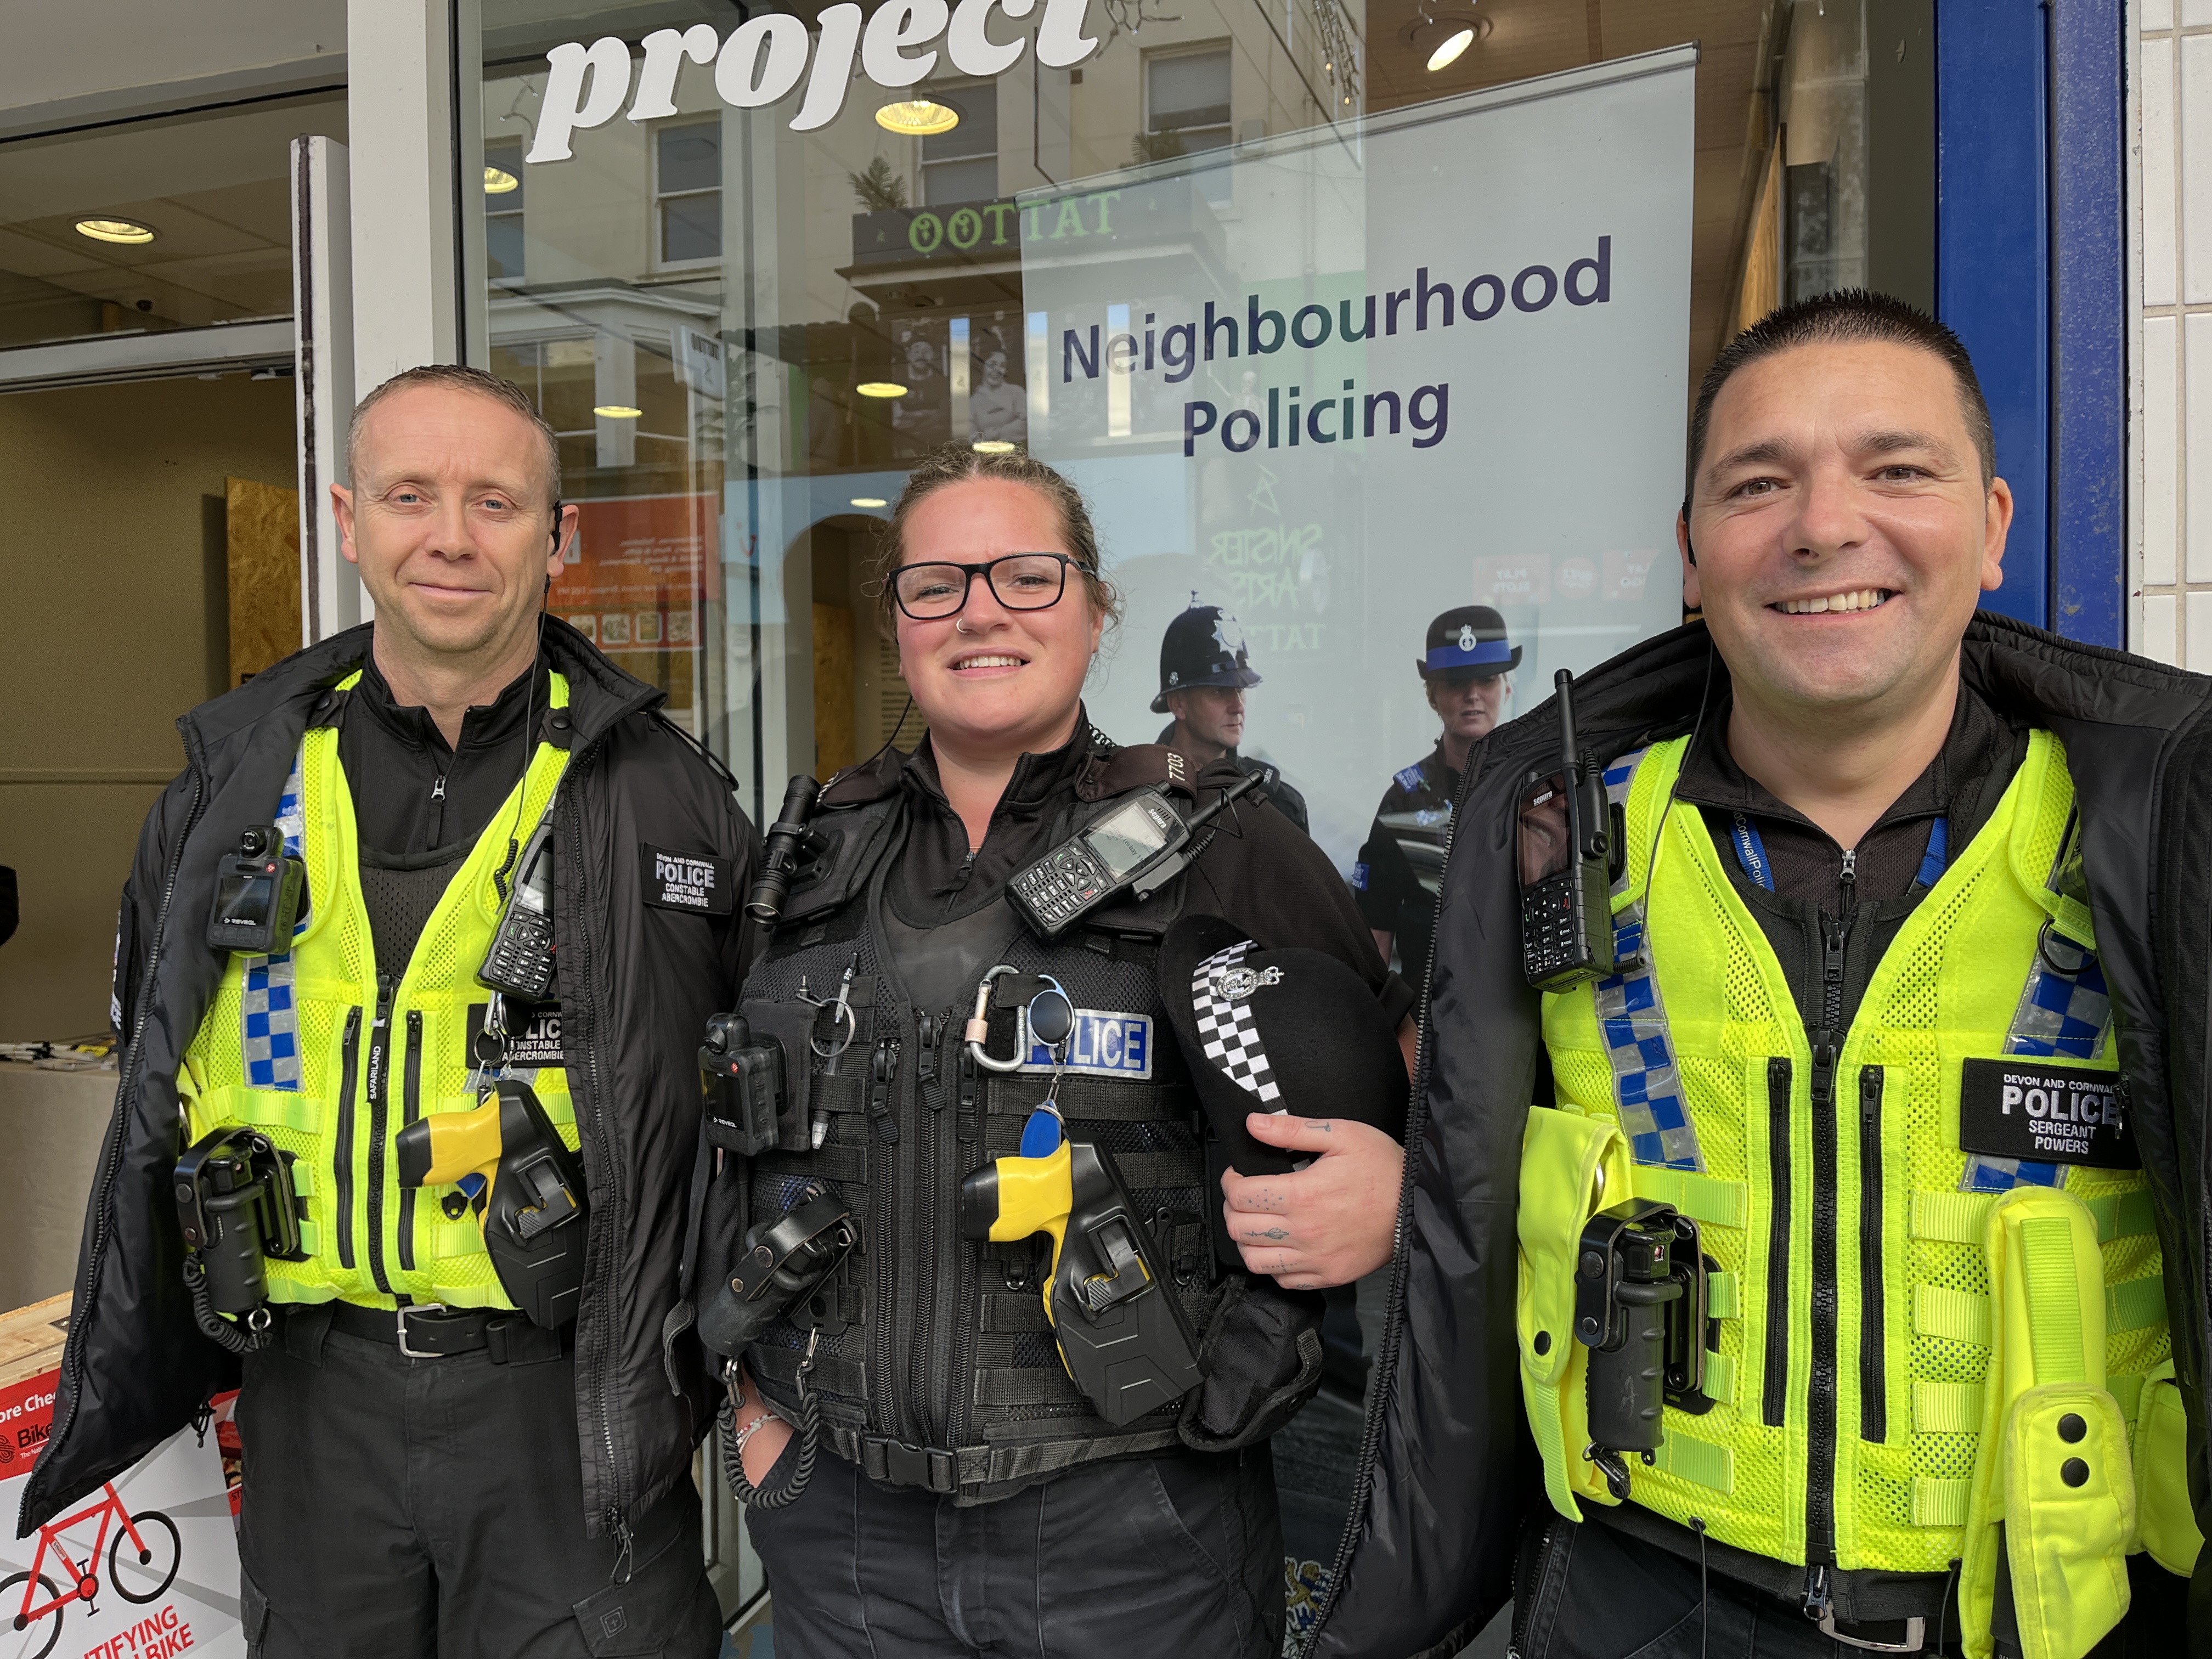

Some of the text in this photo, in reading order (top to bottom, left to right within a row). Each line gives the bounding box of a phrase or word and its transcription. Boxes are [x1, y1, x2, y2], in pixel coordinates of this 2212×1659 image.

[525, 0, 1098, 163] project
[1062, 235, 1611, 383] Neighbourhood
[1182, 379, 1450, 457] Policing
[1166, 752, 1186, 782] 7703
[1533, 790, 1553, 806] sepura
[1148, 808, 1167, 829] sepura
[1122, 838, 1138, 856] Torbay
[656, 853, 672, 863] DEVON
[685, 859, 715, 870] CORNWALL
[656, 860, 715, 889] POLICE
[661, 892, 709, 907] ABERCROMBIE
[665, 882, 705, 897] CONSTABLE
[516, 1040, 561, 1051] NSTABLE
[1026, 1016, 1142, 1069] PLICE
[501, 1050, 565, 1062] AERCROMBIE
[369, 1045, 382, 1100] SAFARILAND
[2003, 1074, 2114, 1094] DEVON AND CORNWAL
[2001, 1085, 2118, 1125] POLICE
[2028, 1119, 2097, 1139] SERGEANT
[2034, 1136, 2090, 1155] POWERS
[25, 1391, 57, 1412] Che
[20, 1451, 31, 1459] The
[83, 1604, 179, 1659] TIFYING
